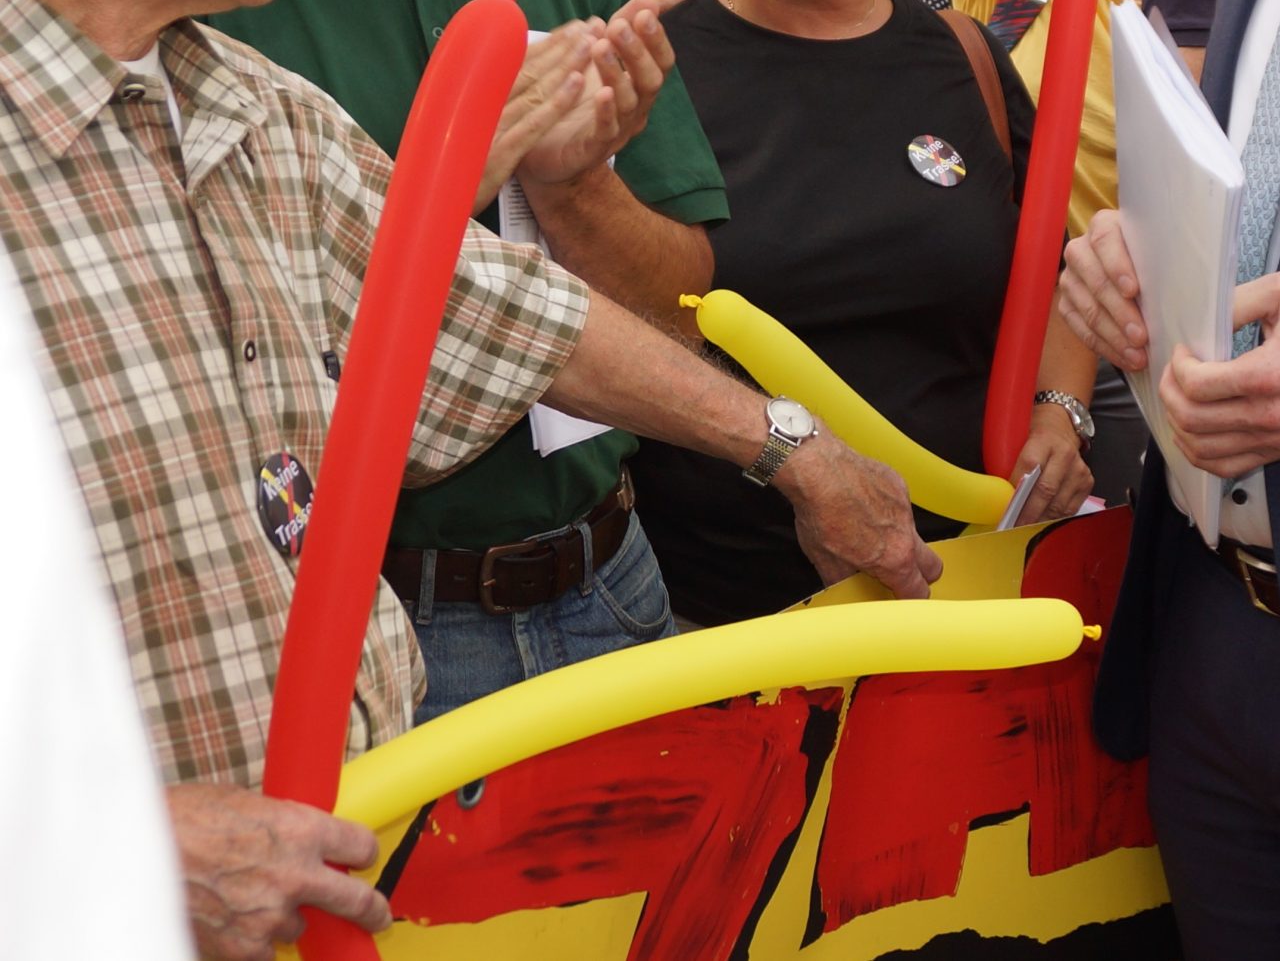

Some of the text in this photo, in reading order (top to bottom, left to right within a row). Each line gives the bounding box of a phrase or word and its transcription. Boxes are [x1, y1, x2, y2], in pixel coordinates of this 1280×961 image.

[911, 139, 944, 163] Keine
[922, 151, 963, 181] Trasse!
[263, 459, 300, 501] Keine
